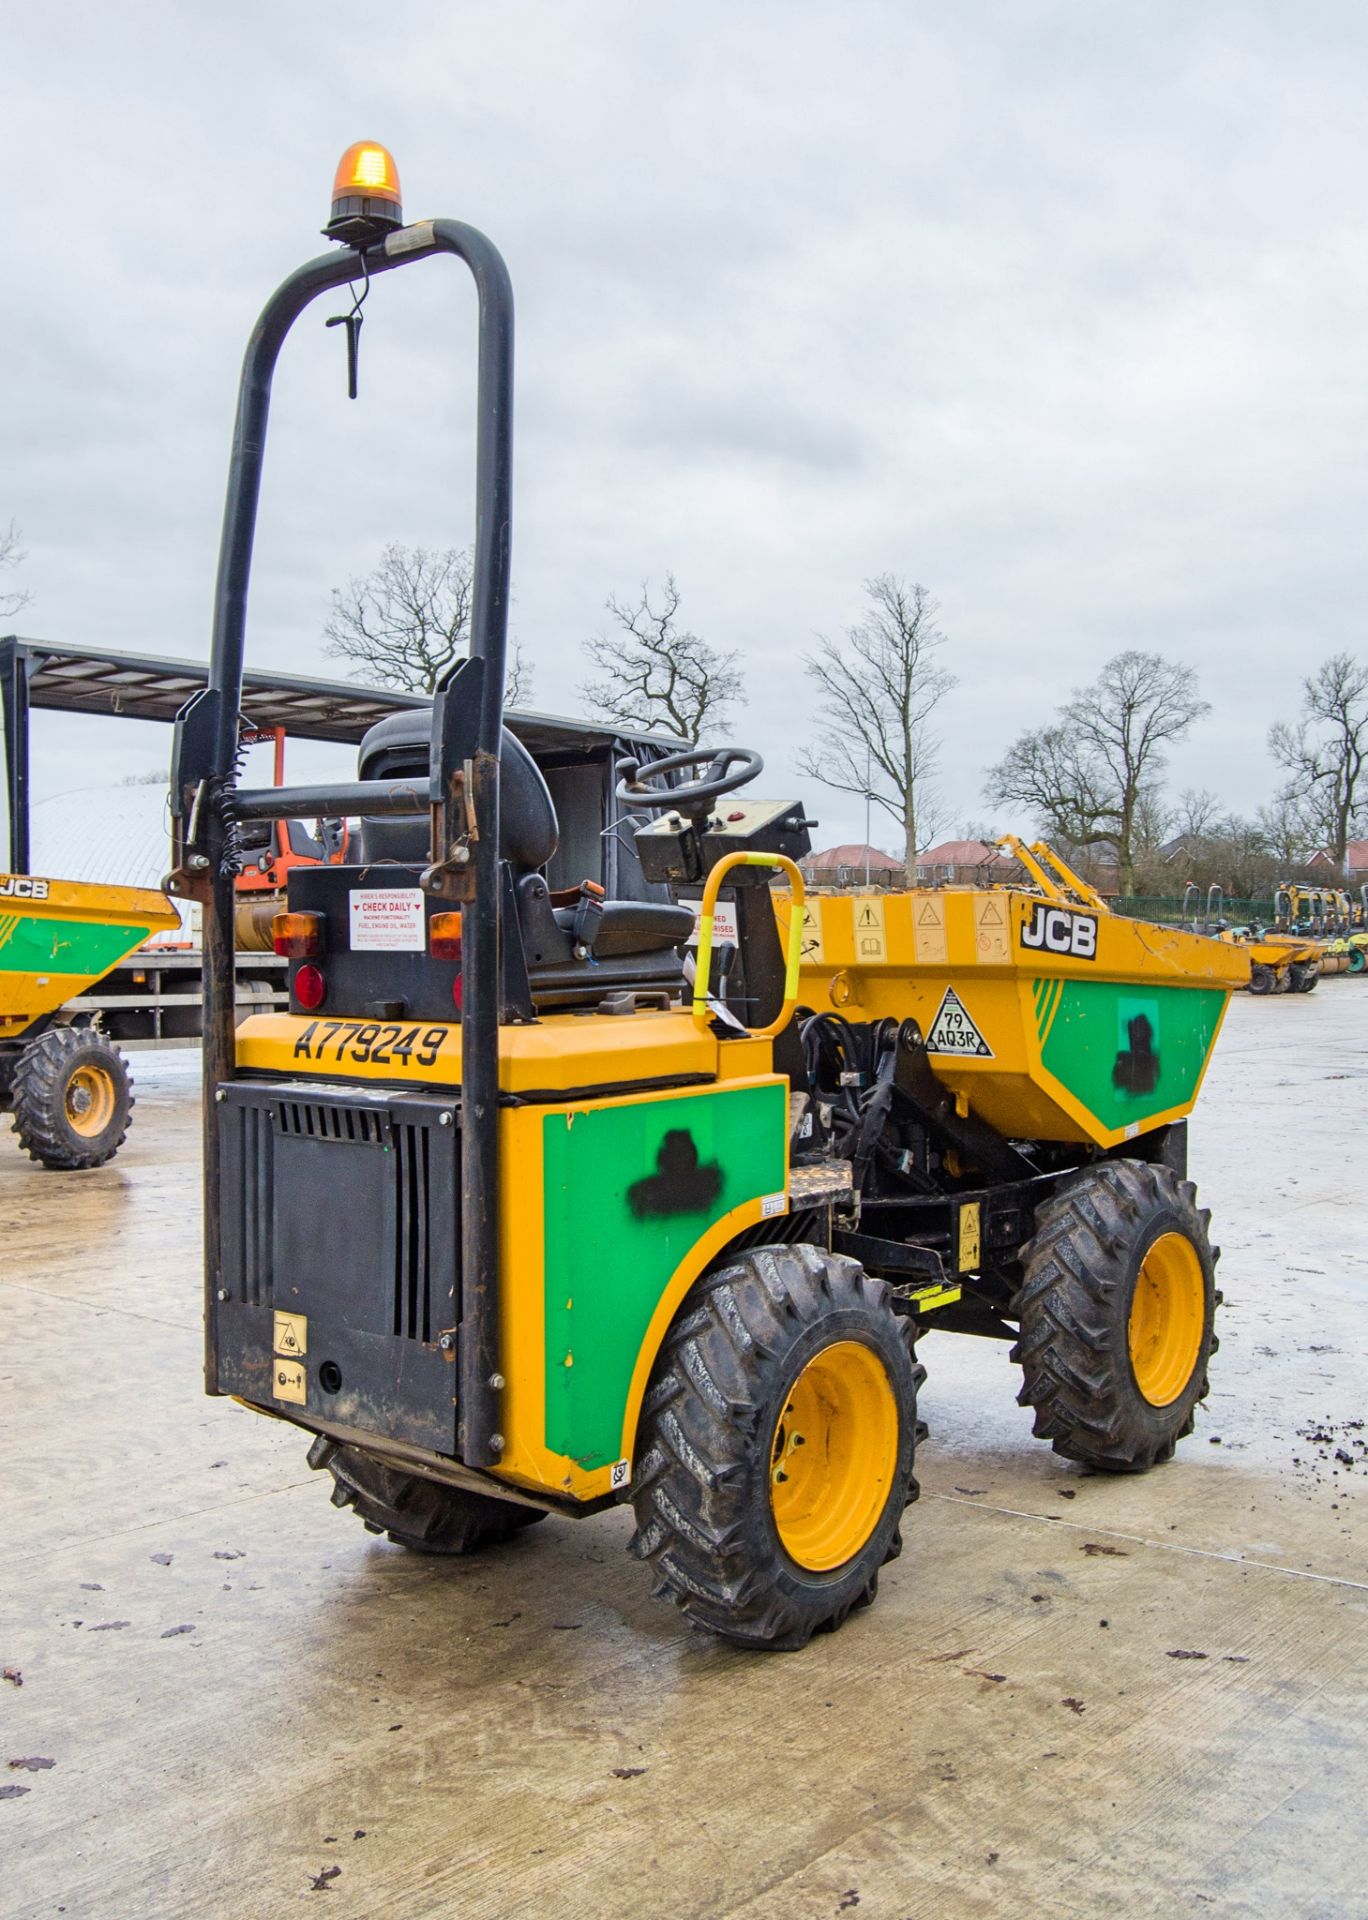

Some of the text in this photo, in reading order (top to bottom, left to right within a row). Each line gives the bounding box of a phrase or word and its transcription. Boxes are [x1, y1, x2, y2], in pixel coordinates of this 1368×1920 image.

[0, 879, 49, 898] JCB
[362, 903, 411, 911] CHECK DAILY
[1022, 907, 1096, 956] JCB
[944, 1012, 963, 1030] 79
[293, 1021, 449, 1066] A779249
[937, 1029, 977, 1049] AQ3R
